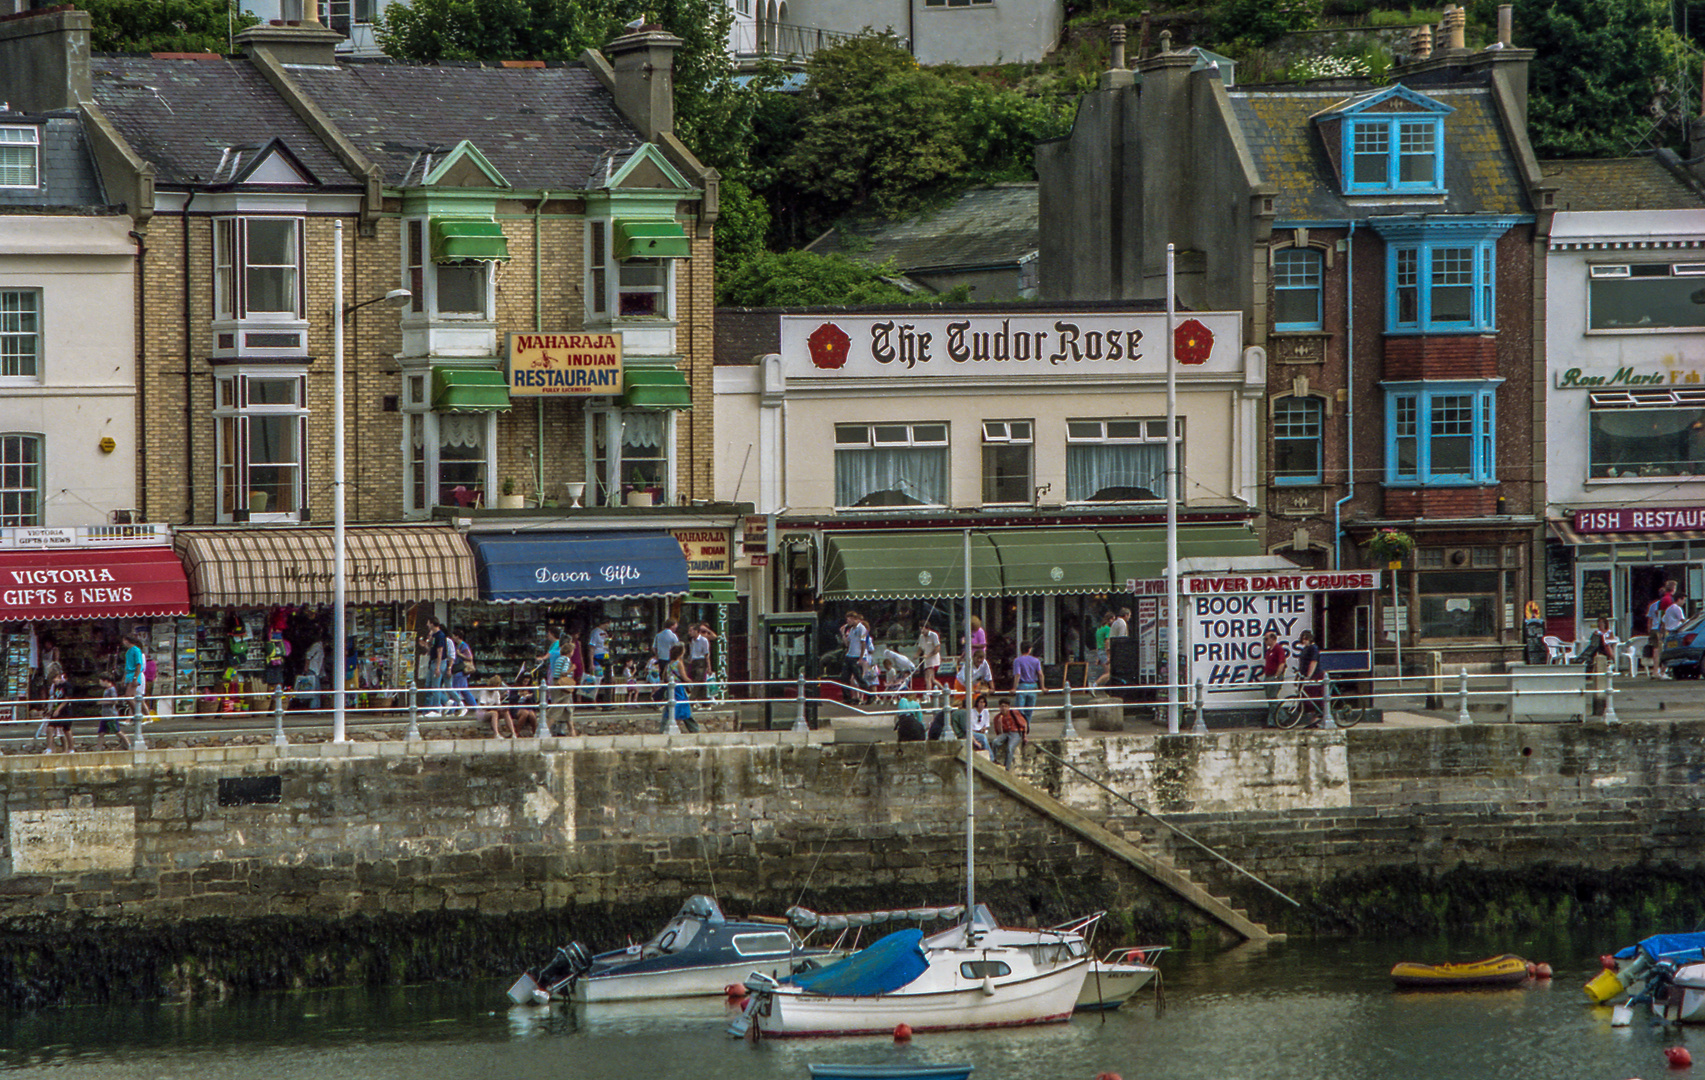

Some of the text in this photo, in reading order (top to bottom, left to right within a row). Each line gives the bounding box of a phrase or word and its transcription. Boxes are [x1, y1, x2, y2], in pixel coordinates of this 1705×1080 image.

[517, 335, 616, 353] MAHARAJA
[871, 319, 1143, 370] The Tudor Rose
[567, 354, 616, 366] INDIAN
[514, 369, 619, 386] RESTAURANT
[1561, 368, 1605, 386] Rose
[1606, 366, 1665, 385] Marie
[1580, 512, 1620, 529] FISH
[701, 546, 725, 555] INDIAN
[535, 564, 640, 585] Devon Gifts
[687, 560, 725, 571] TAURANT
[11, 568, 116, 584] VICTORIA
[351, 564, 397, 588] Edge
[1190, 578, 1248, 593] RIVER
[1251, 576, 1303, 591] DART
[1305, 574, 1374, 589] CRUISE
[3, 587, 133, 605] GIFTS & NEWS
[1196, 596, 1257, 616] BOOK
[1264, 595, 1306, 613] THE
[1200, 617, 1299, 639] TORBAY
[1193, 640, 1303, 662] PRINCSS
